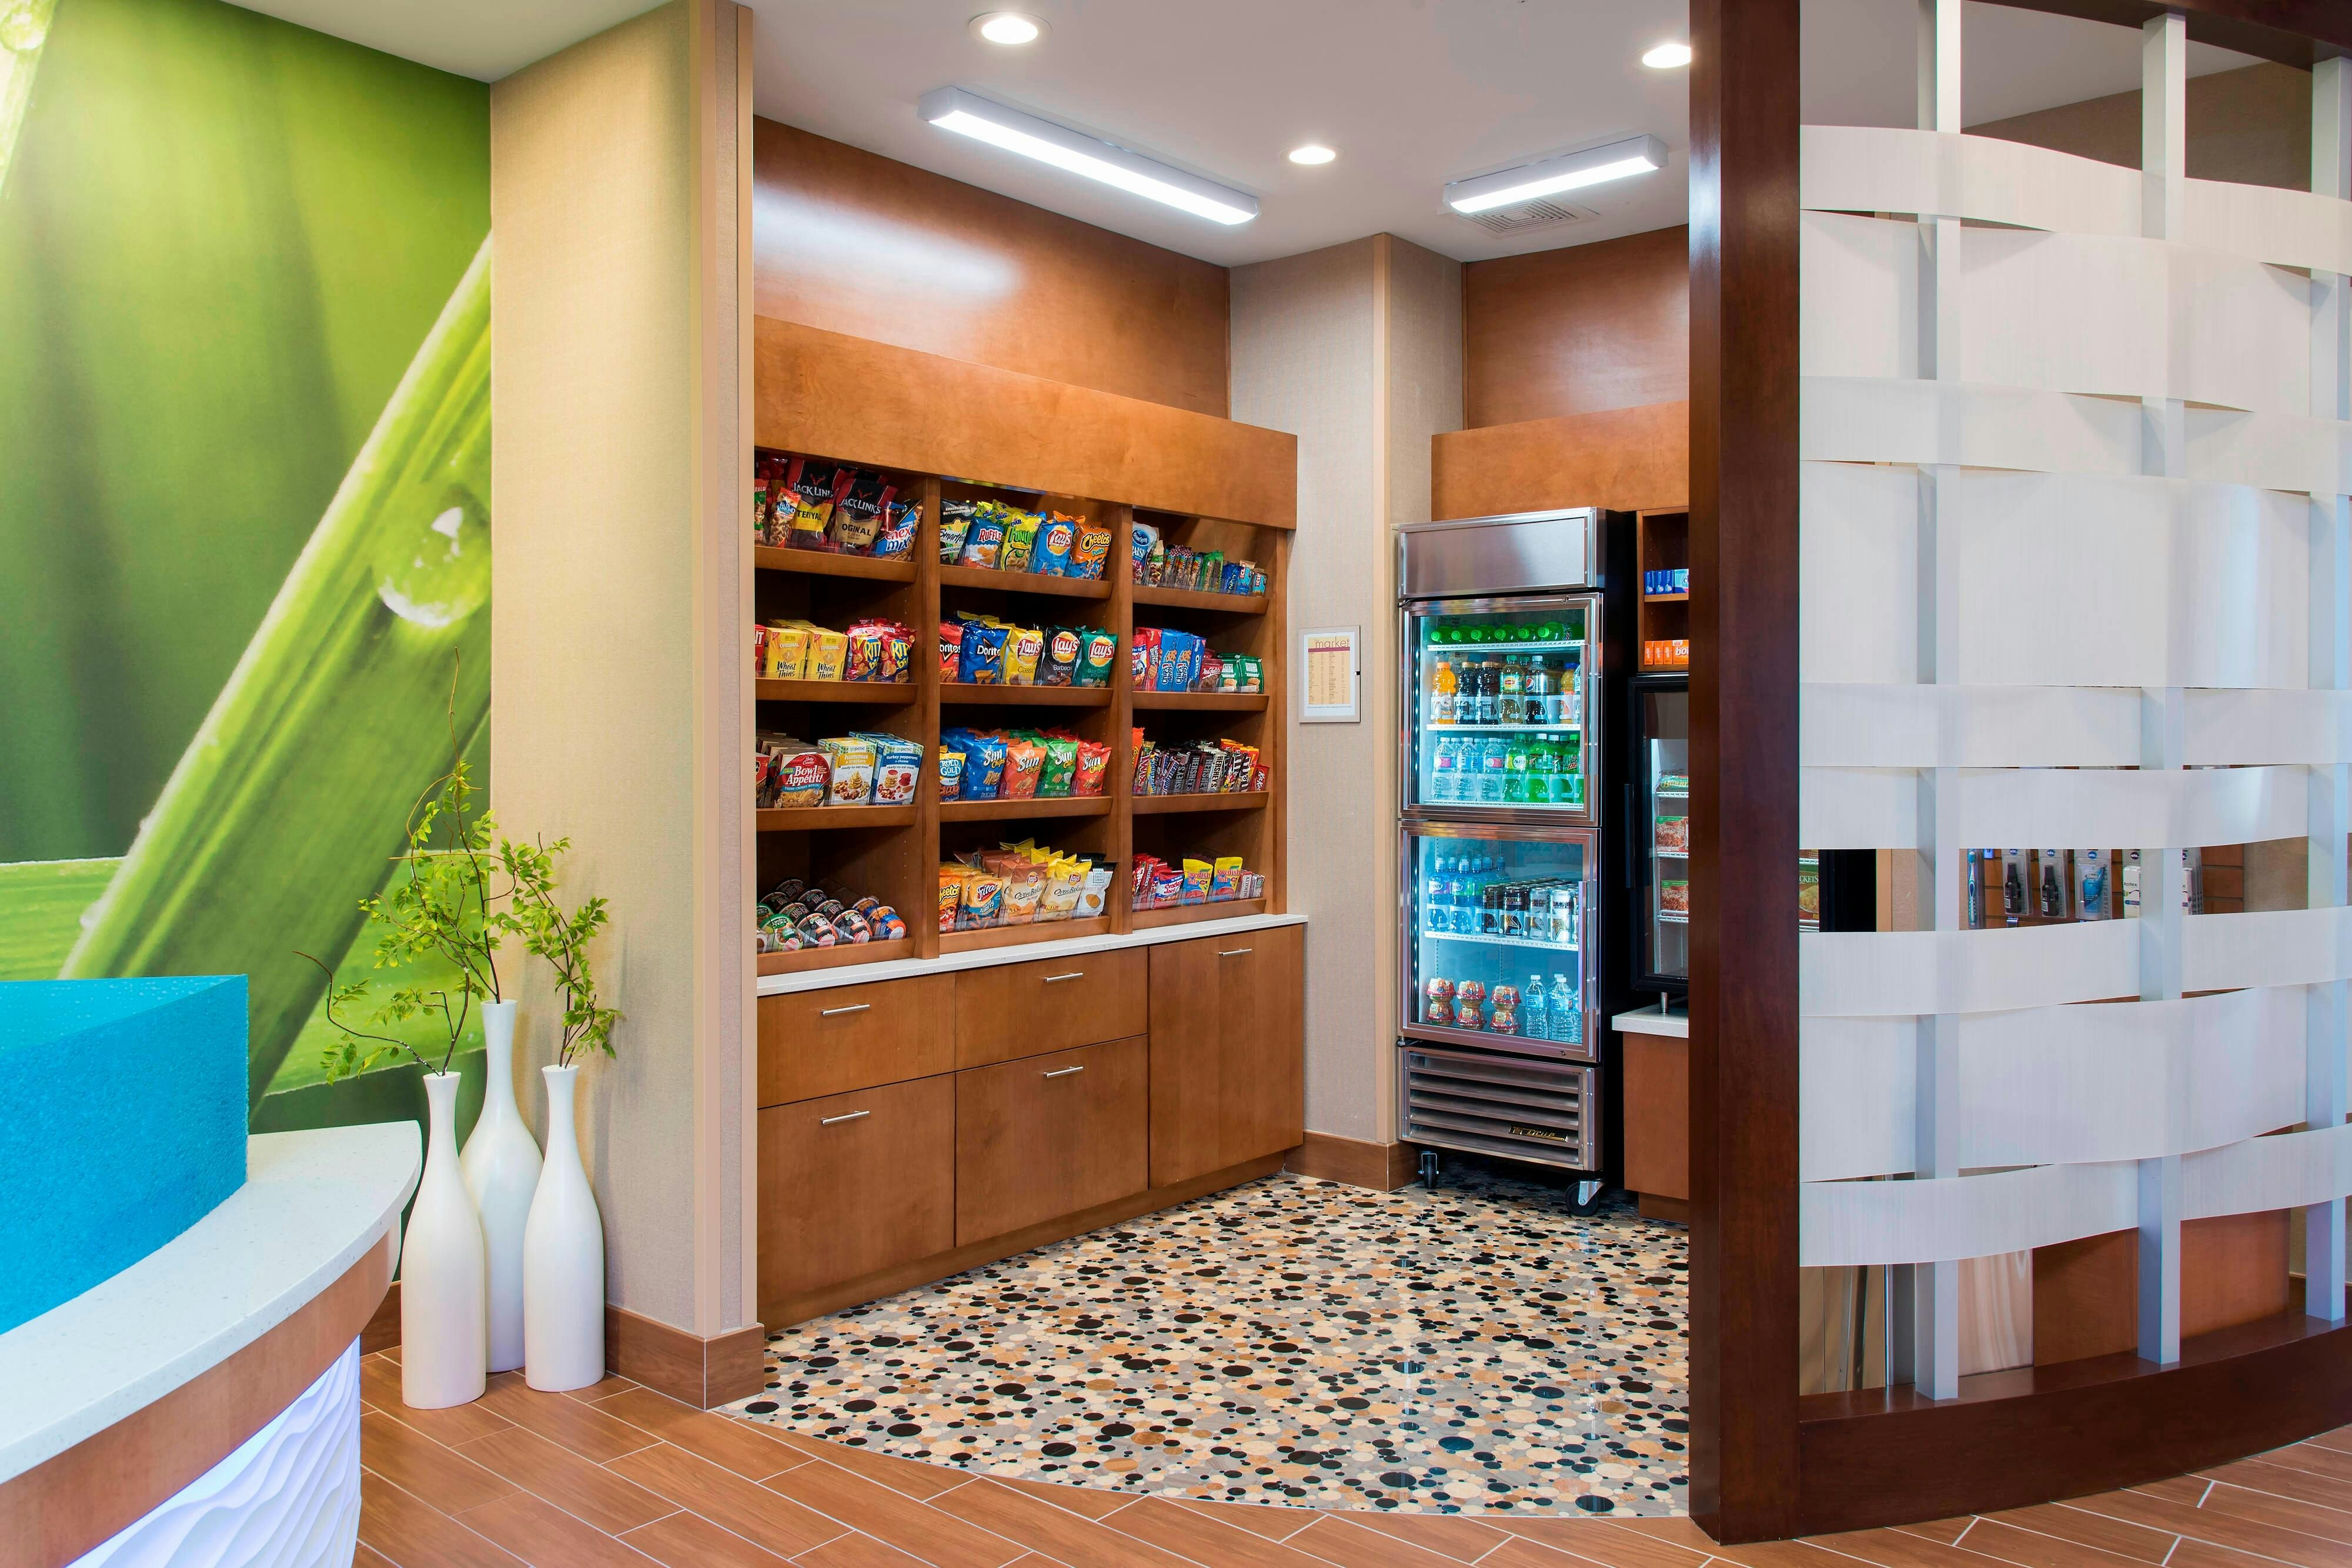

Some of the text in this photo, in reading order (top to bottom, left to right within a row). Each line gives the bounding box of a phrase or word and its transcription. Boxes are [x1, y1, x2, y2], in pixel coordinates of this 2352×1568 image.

[791, 482, 814, 496] JACK
[841, 523, 871, 536] OGINAL
[1082, 532, 1110, 551] Cheetos
[1019, 639, 1041, 656] Lay's
[1055, 638, 1079, 654] Lay's
[1315, 636, 1349, 649] market
[1090, 642, 1113, 658] Lay's
[777, 661, 796, 670] Wheat
[817, 662, 836, 672] Wheat
[941, 758, 960, 767] ROLD
[983, 748, 1003, 767] Sun
[991, 757, 1005, 768] Chips
[1017, 756, 1040, 772] Sun
[1055, 751, 1073, 765] Sun
[1082, 756, 1101, 771] Sun
[794, 765, 818, 777] Bowl
[941, 766, 961, 776] GOLD
[1025, 765, 1040, 775] Chips
[1089, 763, 1106, 774] Chips
[977, 883, 998, 901] Fritos
